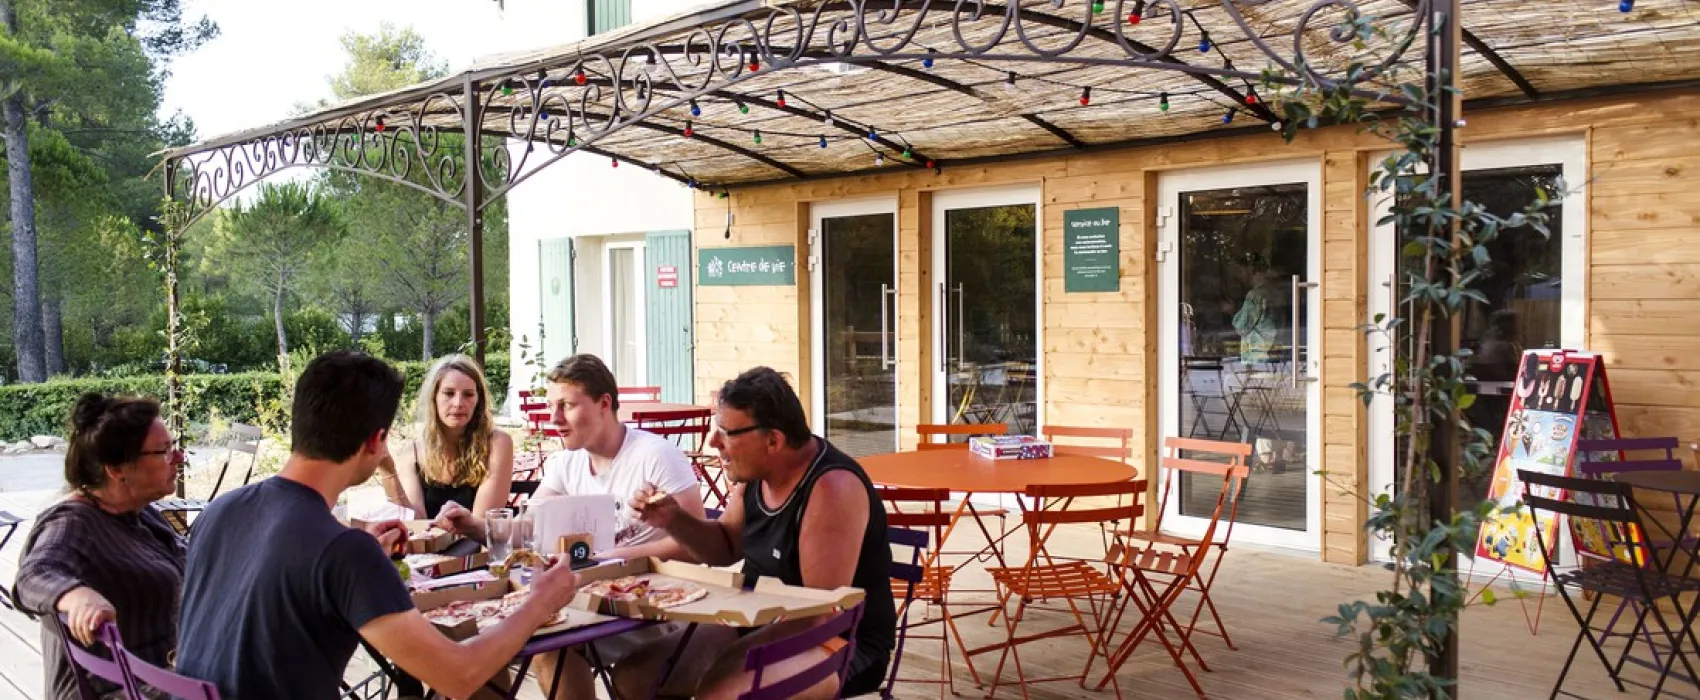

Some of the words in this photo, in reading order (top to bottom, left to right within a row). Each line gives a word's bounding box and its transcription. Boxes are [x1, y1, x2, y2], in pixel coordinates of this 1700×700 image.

[727, 260, 757, 273] Centre
[758, 257, 770, 273] de
[771, 259, 786, 274] vie
[574, 546, 587, 558] 19
